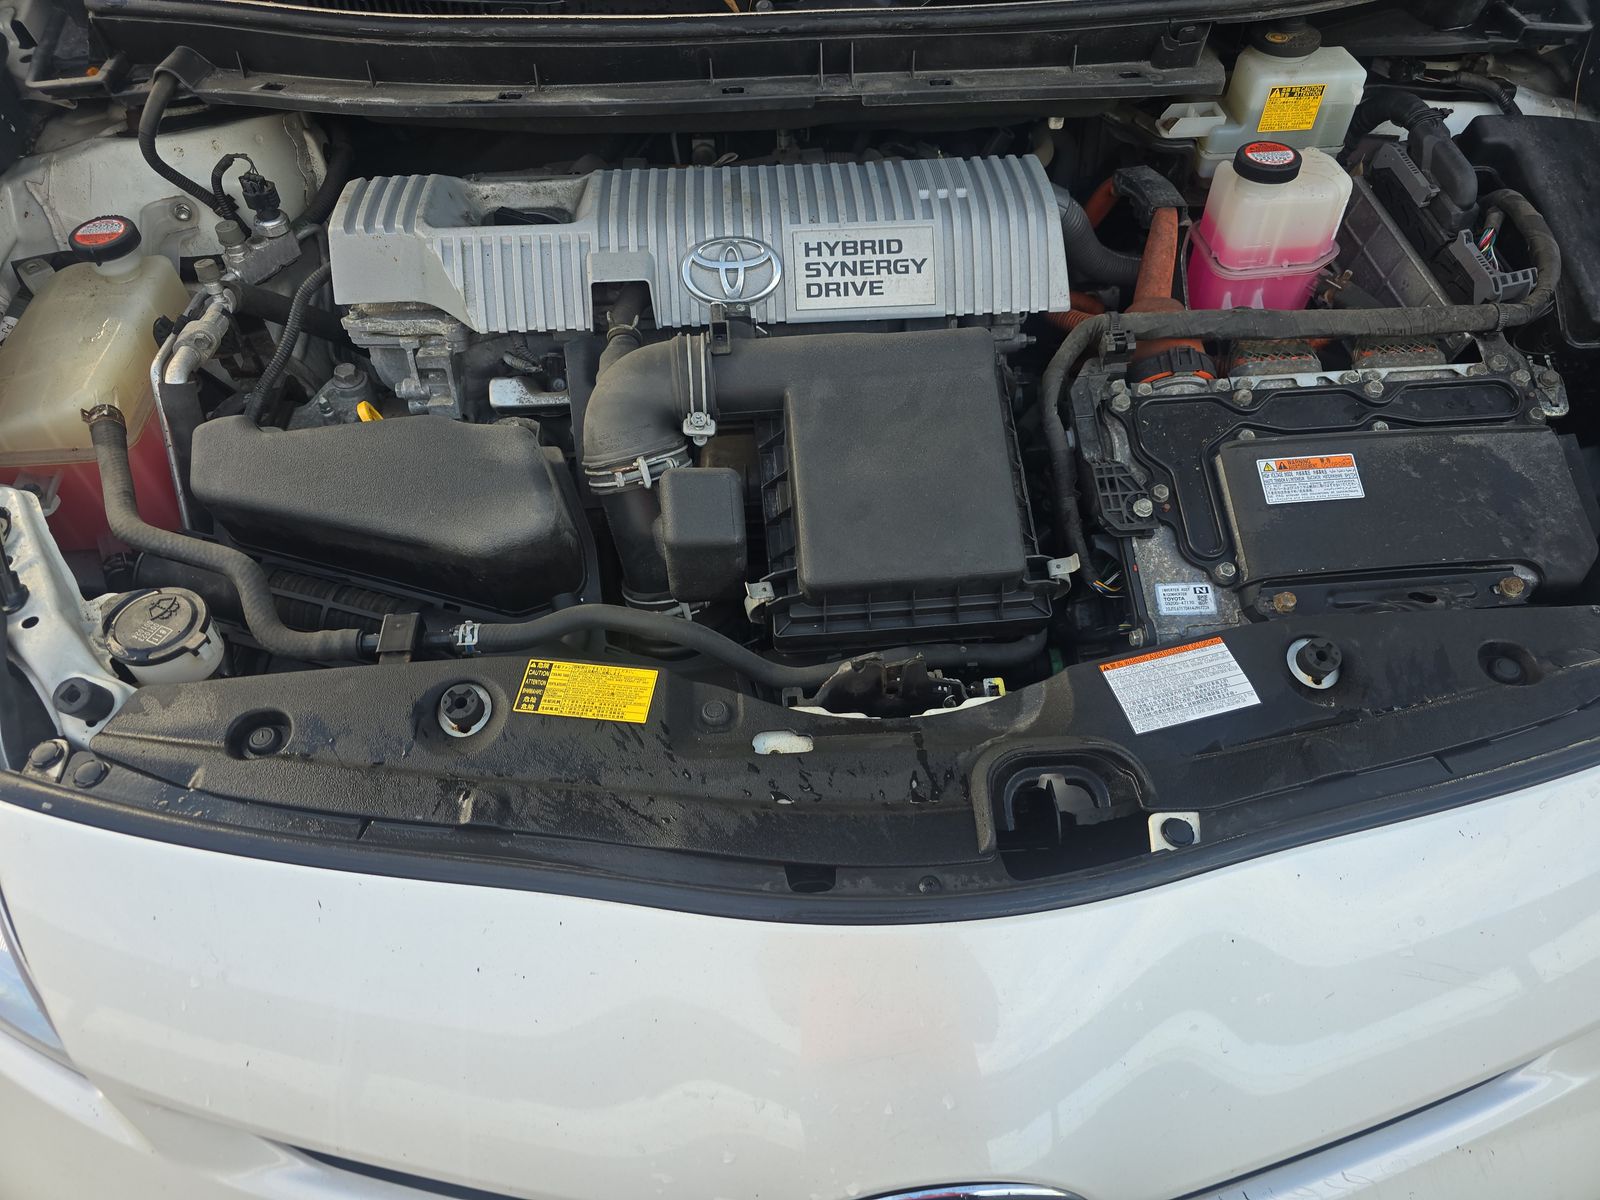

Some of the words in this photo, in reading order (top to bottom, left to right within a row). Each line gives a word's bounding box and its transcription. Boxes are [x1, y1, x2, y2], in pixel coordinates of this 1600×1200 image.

[804, 239, 903, 257] HYBRID
[805, 258, 928, 278] SYNERGY
[806, 280, 884, 298] DRIVE
[525, 678, 547, 686] ATTENTION
[528, 669, 550, 677] CAUTION
